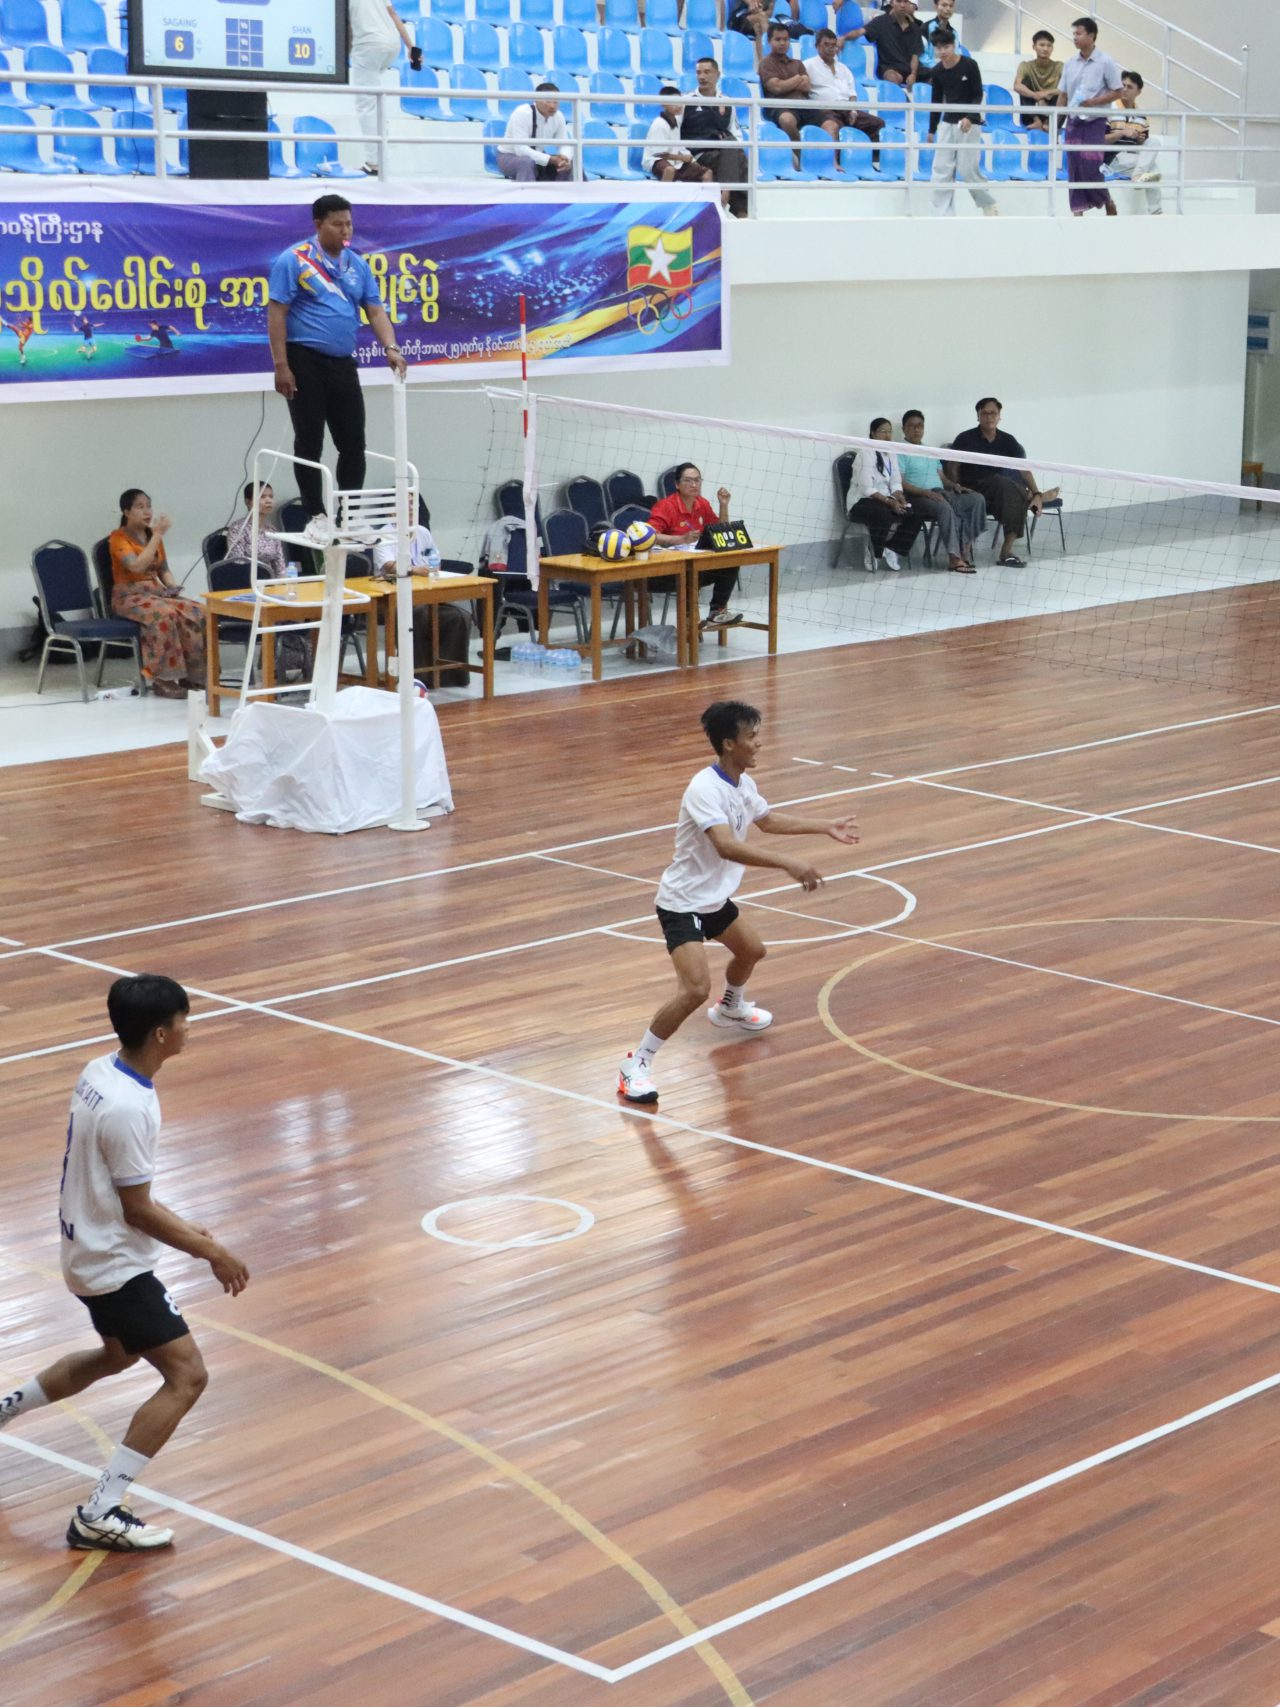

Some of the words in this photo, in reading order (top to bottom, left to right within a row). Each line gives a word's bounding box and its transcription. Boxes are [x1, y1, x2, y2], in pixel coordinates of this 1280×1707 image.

[162, 17, 198, 29] SAGAING
[292, 26, 312, 35] SHAN
[174, 36, 184, 52] 6
[294, 43, 311, 59] 10
[0, 256, 212, 335] သိုလ်ပေါင်းစုံ
[712, 533, 726, 547] 10
[736, 530, 747, 544] 6
[163, 1291, 182, 1316] 8
